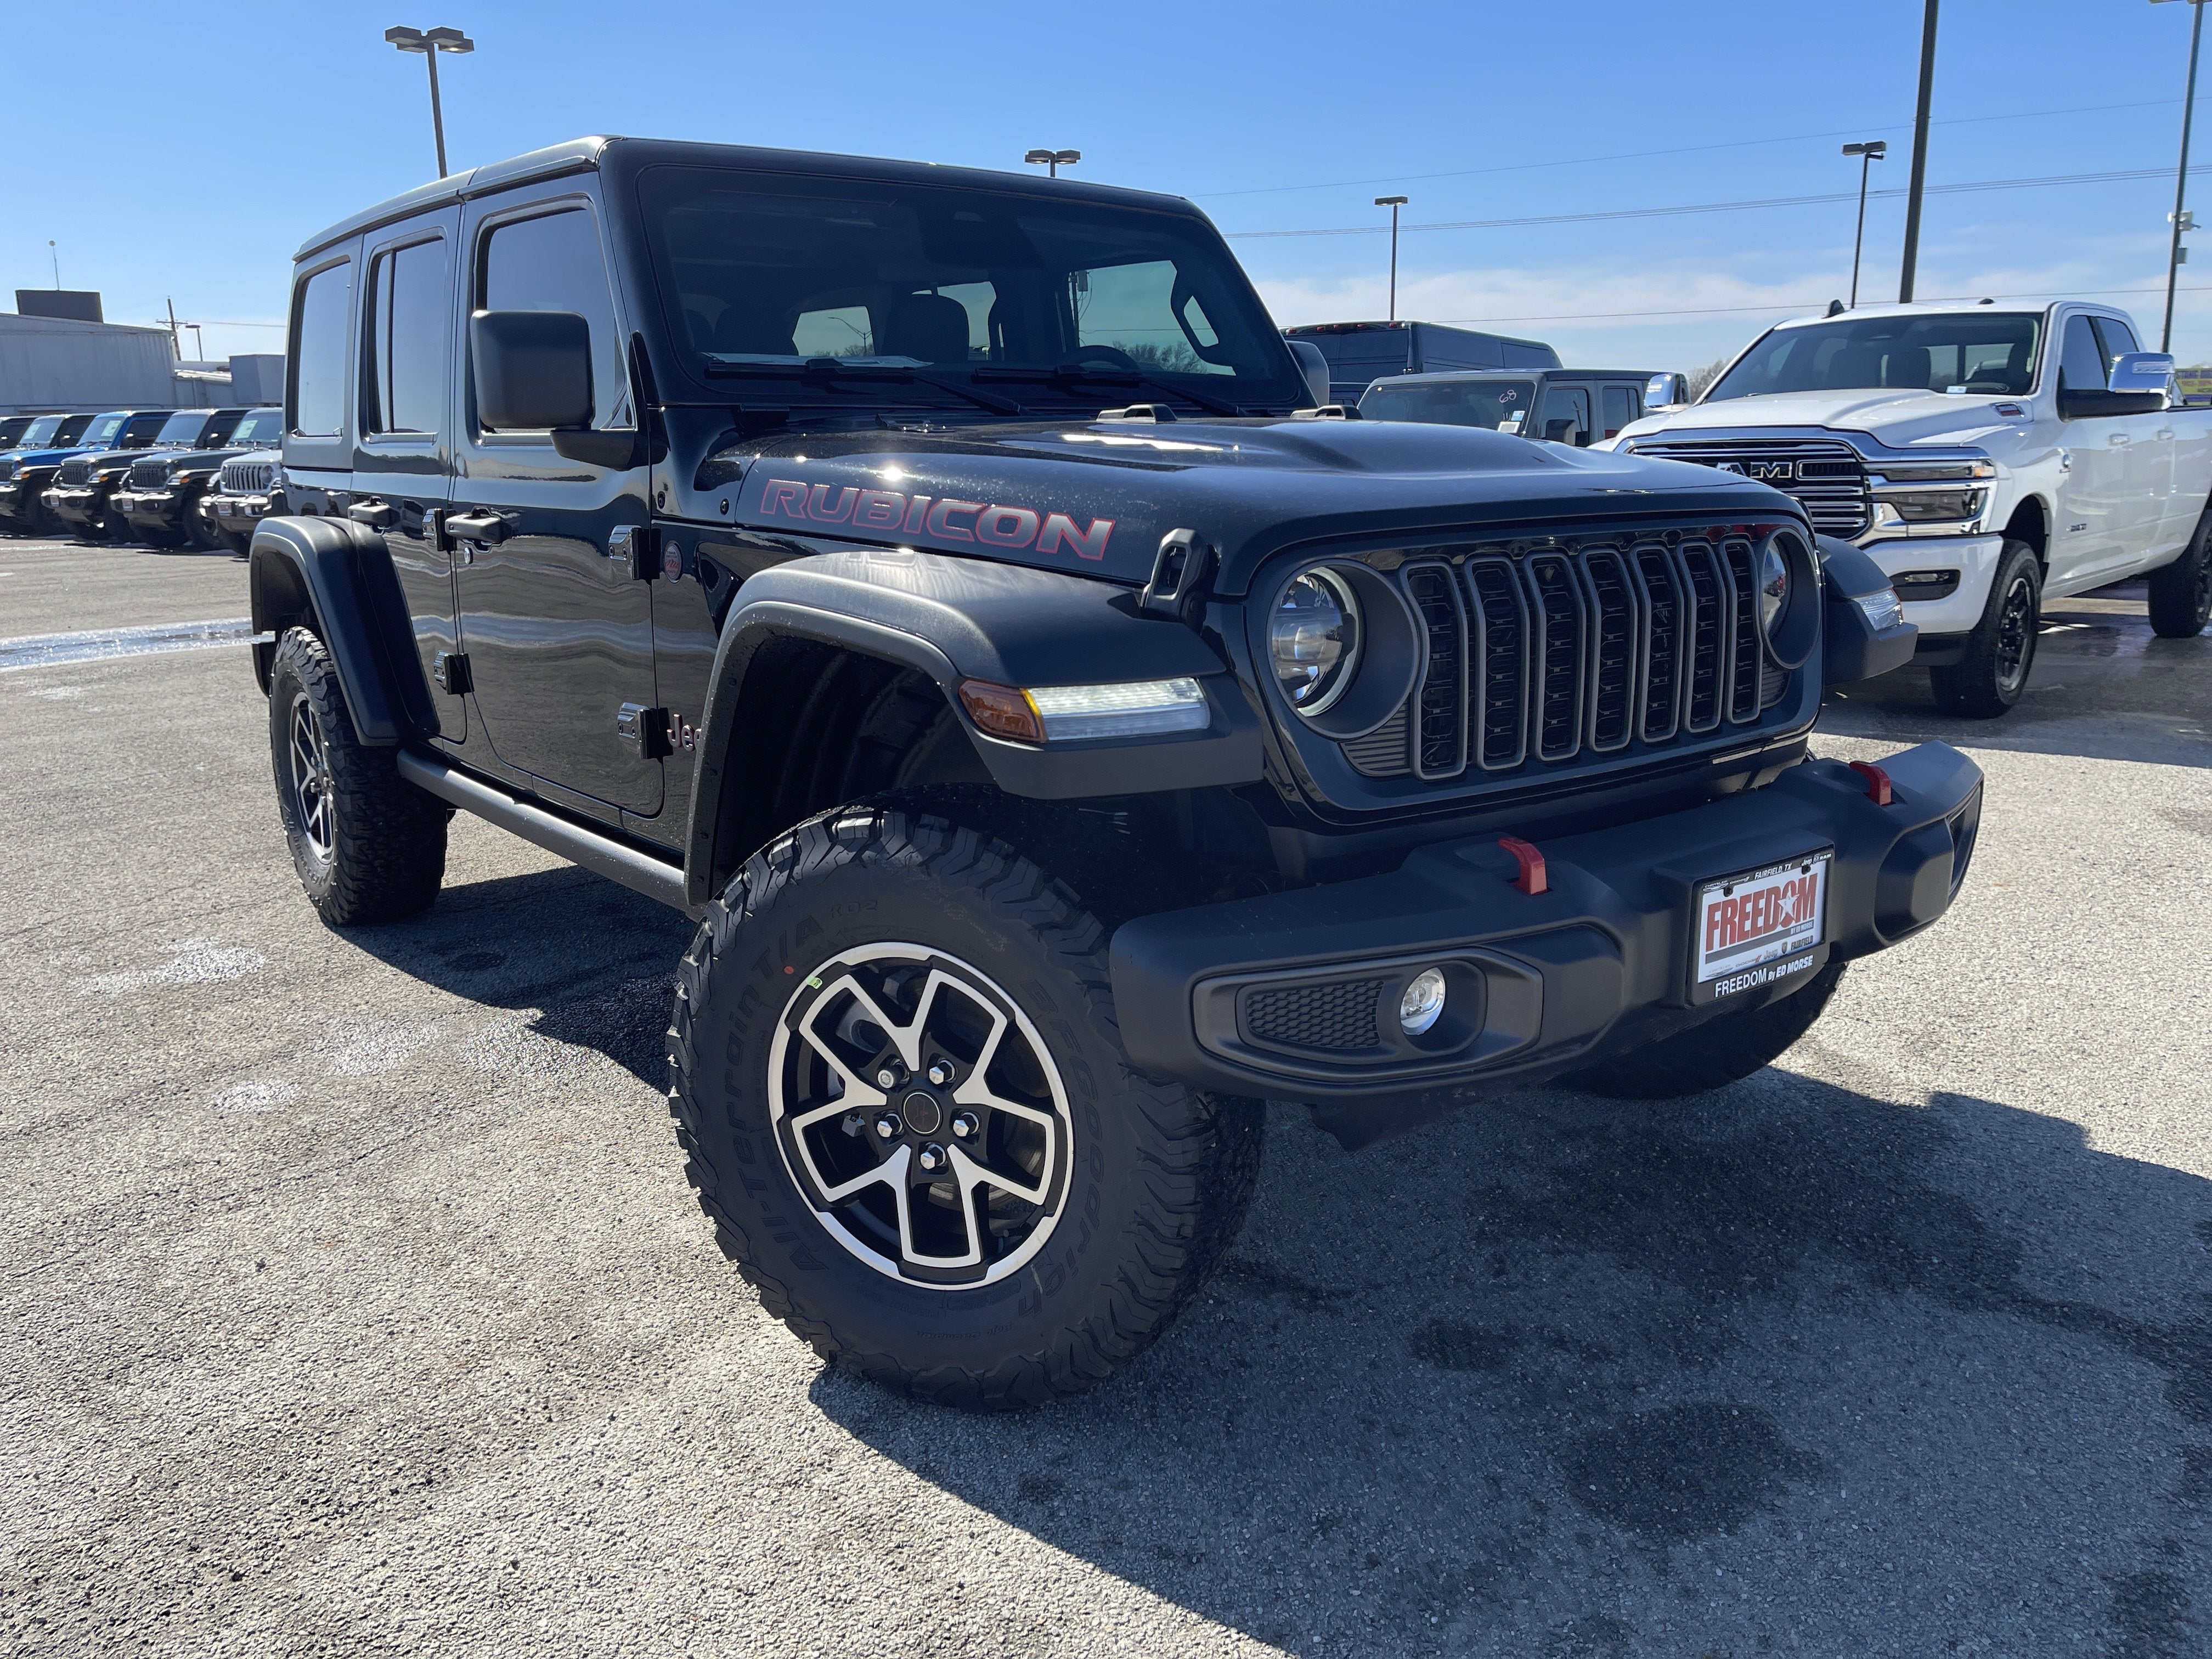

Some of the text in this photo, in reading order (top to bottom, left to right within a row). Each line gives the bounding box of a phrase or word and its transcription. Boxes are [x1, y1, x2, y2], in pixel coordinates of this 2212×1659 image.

[1499, 389, 1517, 403] 68
[1716, 461, 1792, 478] AM
[760, 479, 1115, 561] RUBICON
[1784, 863, 1792, 872] TX
[1706, 873, 1818, 952] FREEDOM
[752, 915, 823, 980] T/A
[1791, 935, 1813, 951] FAIRFIELD
[1715, 968, 1767, 997] FREEDOM
[1776, 964, 1786, 978] ED
[1787, 955, 1813, 974] MORSE
[724, 985, 828, 1271] All-Terrain
[1018, 979, 1104, 1318] BFGoodrich
